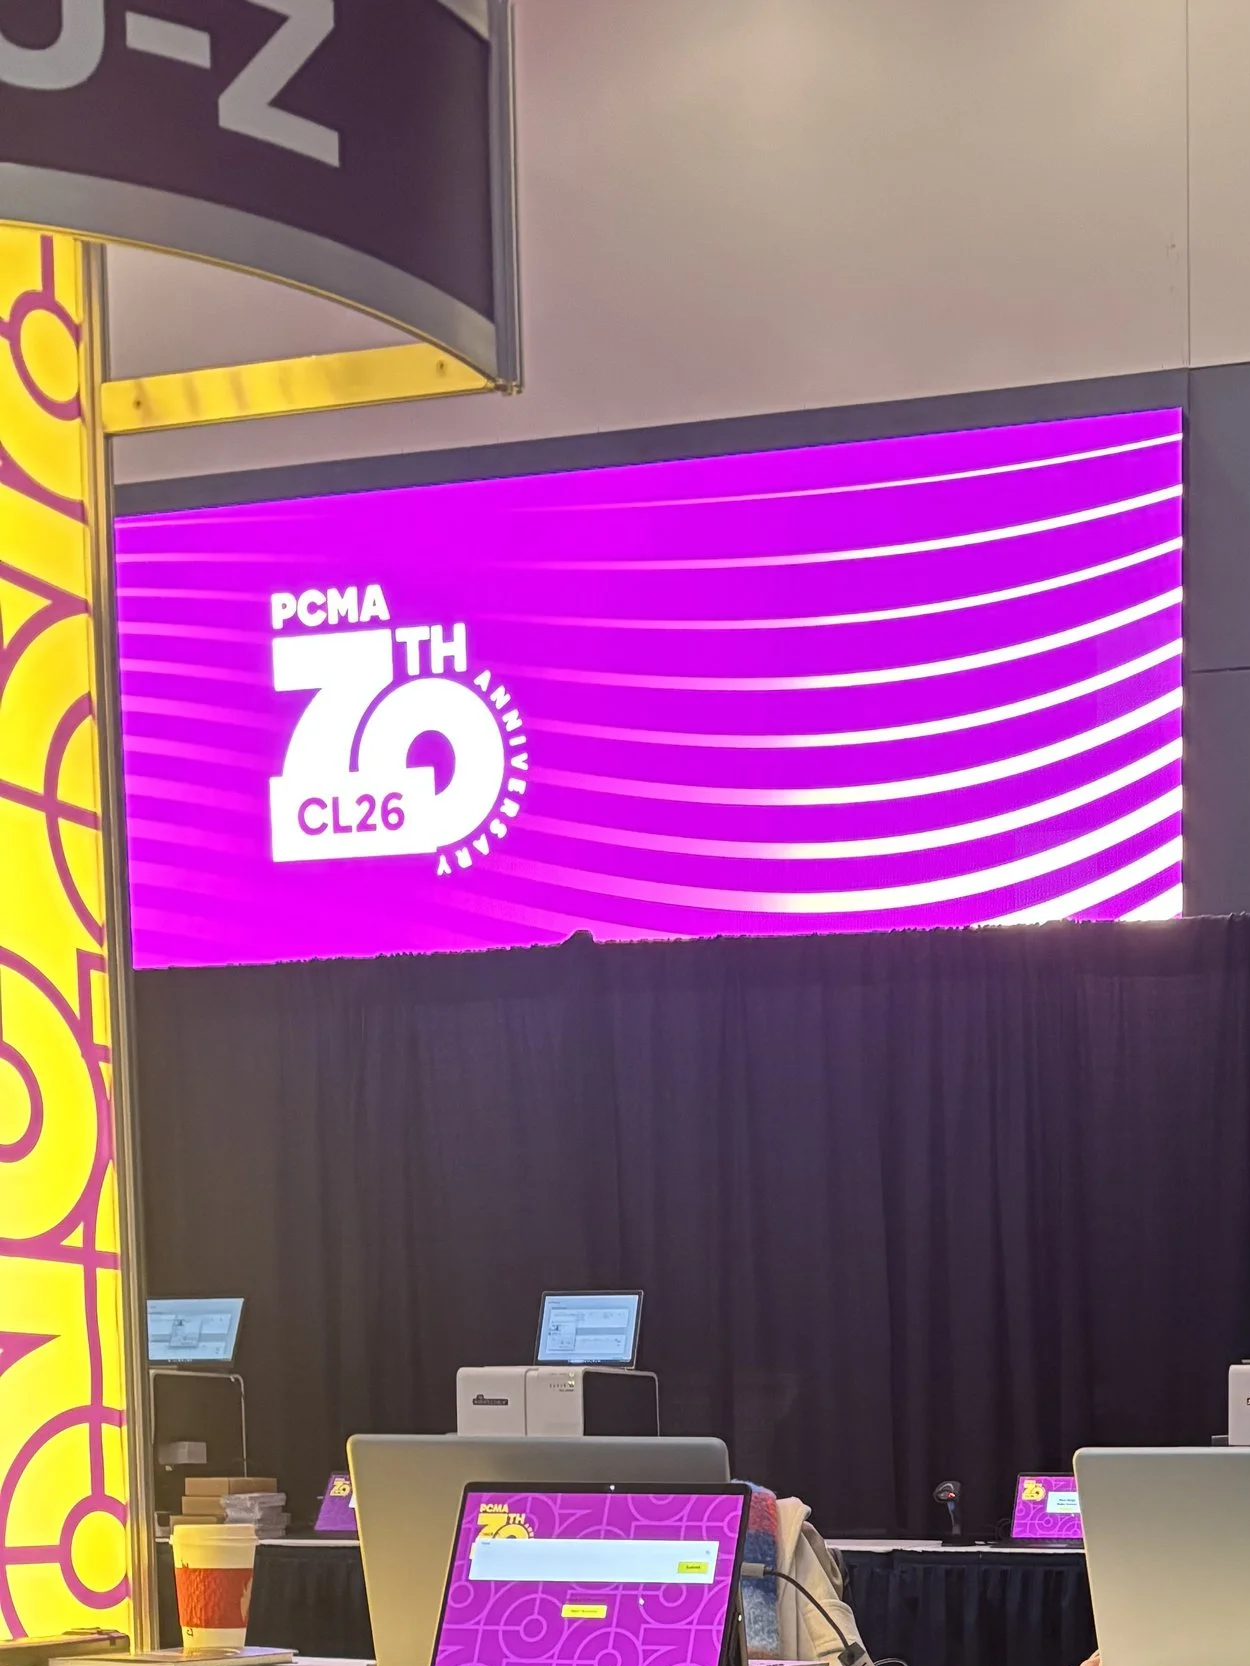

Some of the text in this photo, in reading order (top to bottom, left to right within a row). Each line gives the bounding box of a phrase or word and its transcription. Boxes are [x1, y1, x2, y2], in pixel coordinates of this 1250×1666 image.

[271, 584, 390, 629] PCMA
[436, 669, 529, 877] ANNIVERSARY
[297, 791, 405, 836] CL26
[479, 1503, 509, 1513] PCMA
